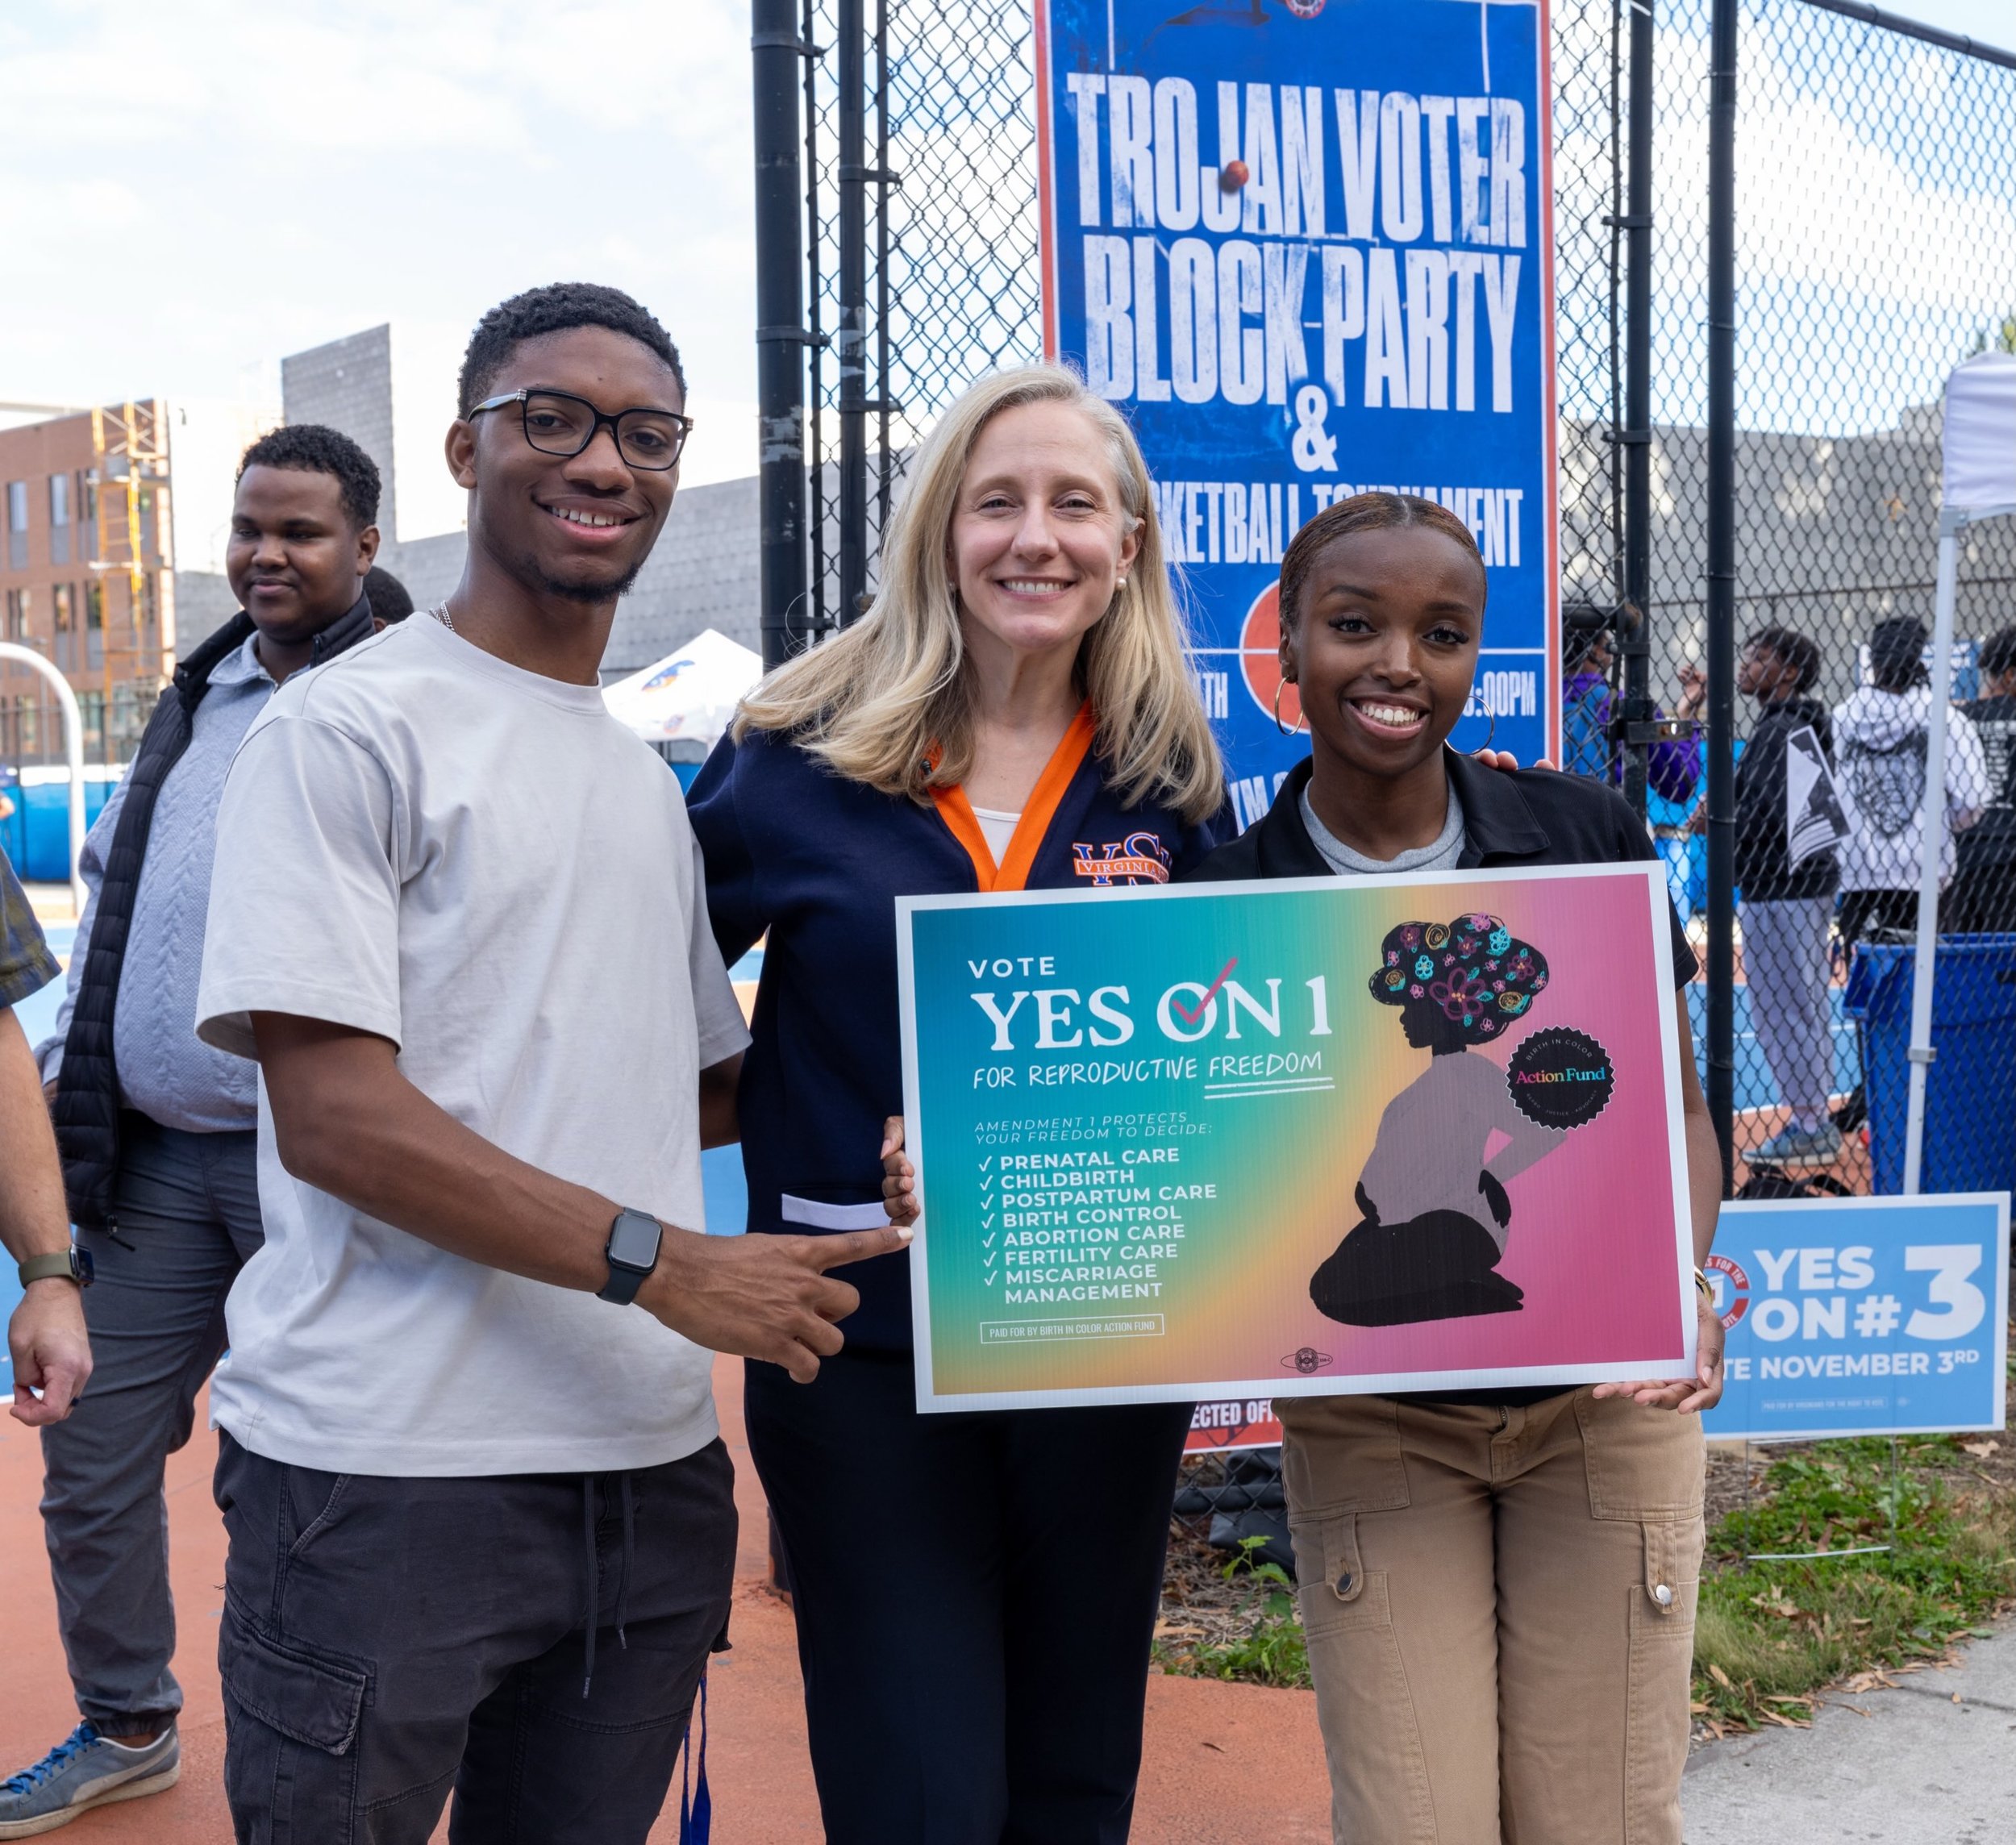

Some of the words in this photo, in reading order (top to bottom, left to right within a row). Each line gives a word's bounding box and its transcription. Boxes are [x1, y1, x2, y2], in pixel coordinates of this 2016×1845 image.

[1067, 73, 1326, 237] TROJAN
[1334, 87, 1527, 248] VOTER
[1082, 234, 1309, 405] BLOCK
[1321, 244, 1522, 413] PARTY
[1291, 384, 1339, 473] &
[968, 956, 1056, 979] VOTE
[970, 985, 1135, 1052] YES
[1156, 977, 1283, 1043] ON
[1306, 974, 1333, 1035] 1
[1526, 1042, 1548, 1061] BIRTH
[1565, 1039, 1593, 1059] COLOR
[973, 1066, 1017, 1089] FOR
[1029, 1057, 1197, 1087] REPRODUCTIVE
[1209, 1051, 1322, 1078] FREEDOM
[1515, 1069, 1565, 1085] Action
[1565, 1066, 1606, 1082] Fund
[975, 1117, 1083, 1133] AMENDMENT
[1089, 1116, 1095, 1127] 1
[1102, 1112, 1187, 1126] PROTECTS
[976, 1131, 1021, 1145] YOUR
[1028, 1128, 1110, 1143] FREEDOM
[1118, 1126, 1138, 1139] TO
[1144, 1123, 1213, 1137] DECIDE:
[1000, 1151, 1114, 1171] PRENATAL
[1122, 1147, 1180, 1164] CARE
[1001, 1169, 1135, 1189] CHILDBIRTH
[1002, 1188, 1151, 1209] POSTPARTUM
[1159, 1184, 1218, 1202] CARE
[1003, 1210, 1068, 1227] BIRTH
[1076, 1206, 1181, 1224] CONTROL
[1003, 1227, 1120, 1247] ABORTION
[1127, 1223, 1185, 1241] CARE
[1005, 1247, 1113, 1266] FERTILITY
[1119, 1243, 1178, 1260] CARE
[1006, 1264, 1158, 1285] MISCARRIAGE
[1753, 1245, 1876, 1292] YES
[1005, 1282, 1163, 1305] MANAGEMENT
[989, 1327, 1008, 1339] PAID
[1010, 1326, 1026, 1338] FOR
[1027, 1326, 1039, 1337] BY
[1039, 1325, 1064, 1336] BIRTH
[1065, 1324, 1073, 1335] IN
[1075, 1322, 1102, 1335] COLOR
[1104, 1322, 1133, 1333] ACTION
[1134, 1320, 1156, 1331] FUND
[1751, 1296, 1847, 1343] ON
[1760, 1351, 1930, 1380] NOVEMBER
